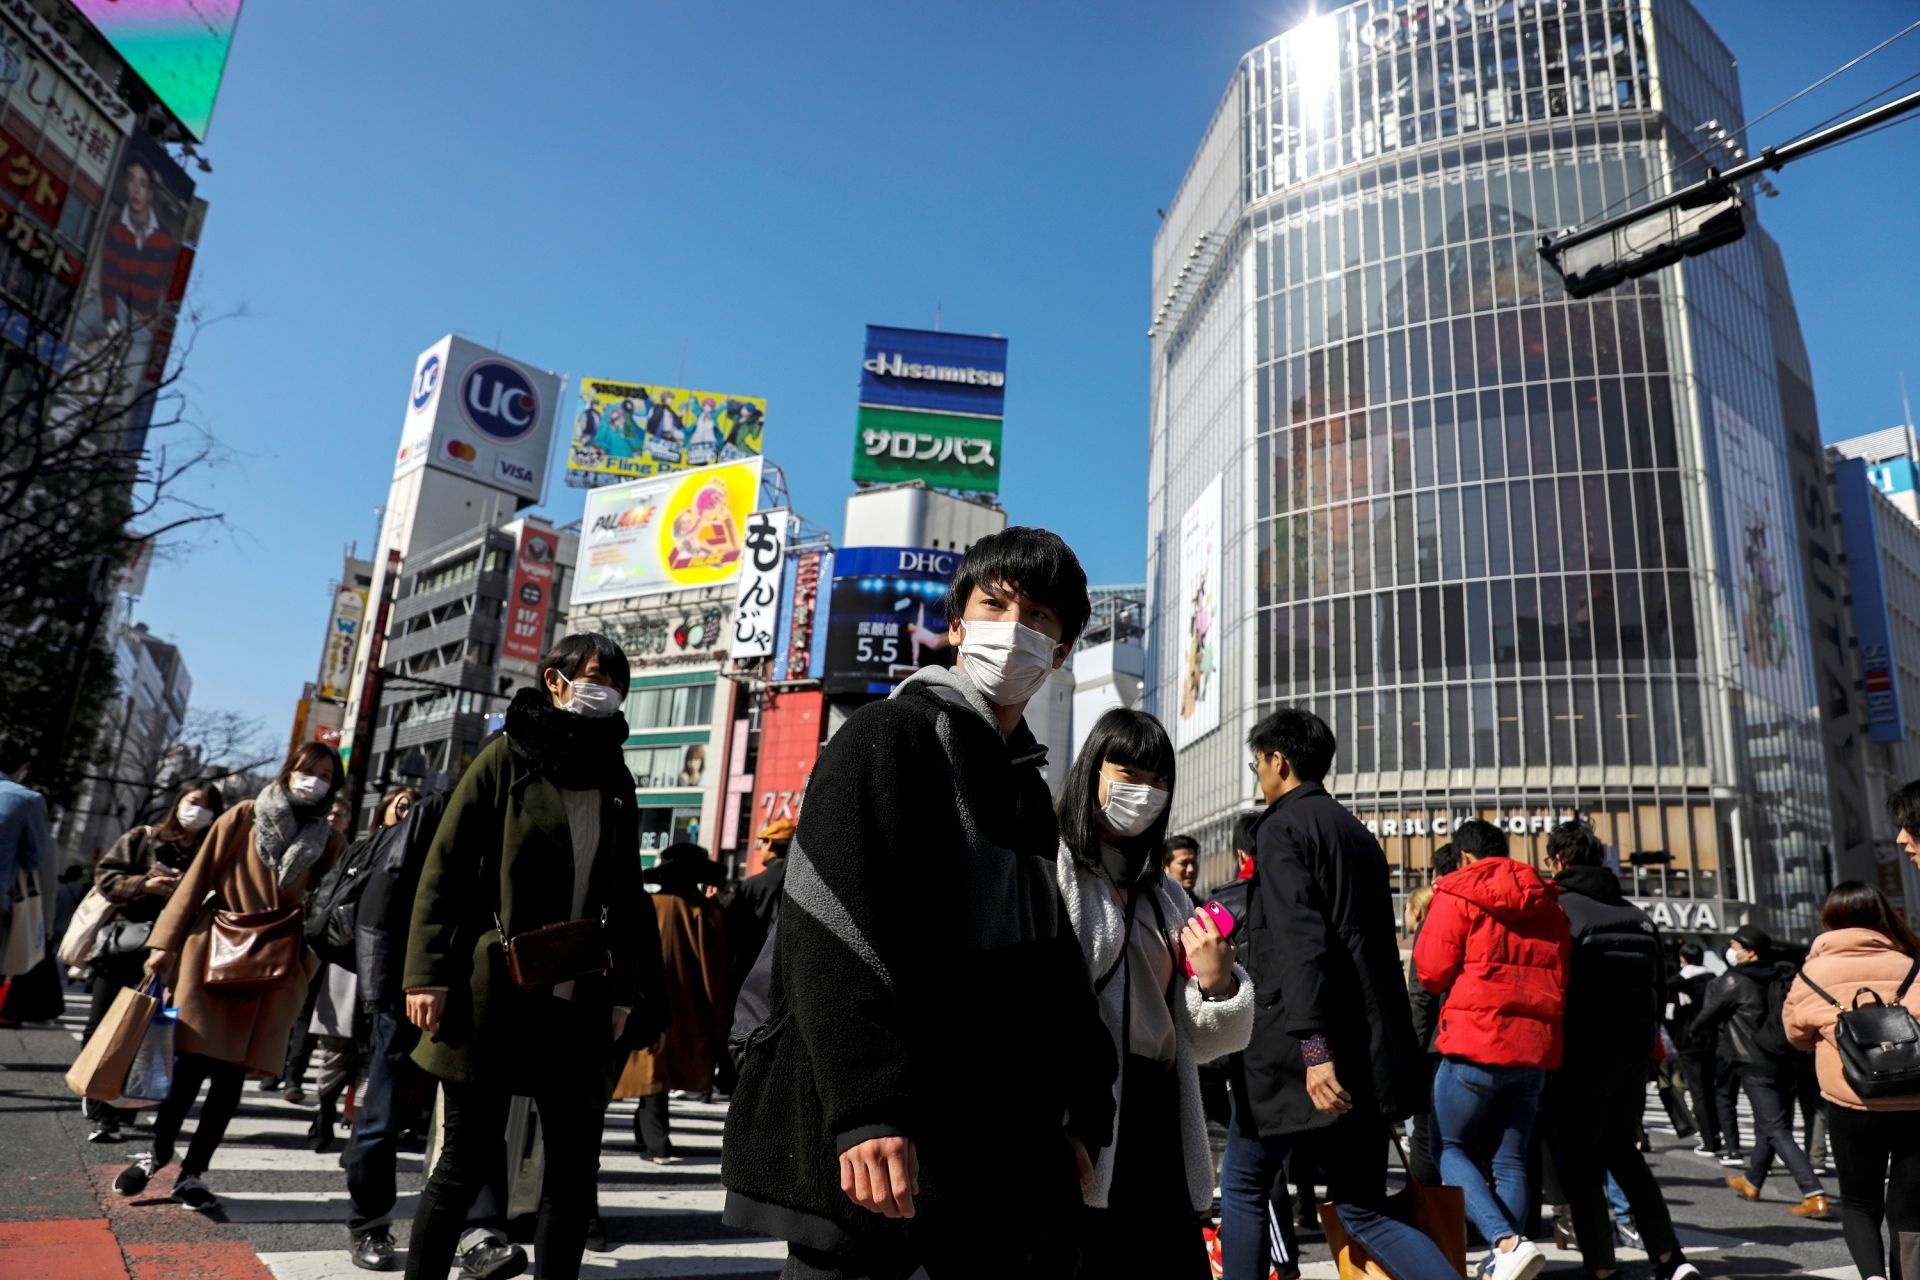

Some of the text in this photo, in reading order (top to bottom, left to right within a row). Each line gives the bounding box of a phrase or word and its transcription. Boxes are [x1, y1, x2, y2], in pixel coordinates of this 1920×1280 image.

[863, 352, 1005, 388] Hisamitsu
[469, 373, 532, 427] UC
[862, 428, 996, 467] サロンパス
[500, 460, 534, 484] VISA
[606, 457, 653, 475] Fling
[898, 551, 953, 575] DHC
[736, 513, 780, 651] もんじゃ
[857, 621, 899, 636] 尿酸値
[856, 637, 899, 663] 5.5
[1863, 642, 1897, 724] SEIBU
